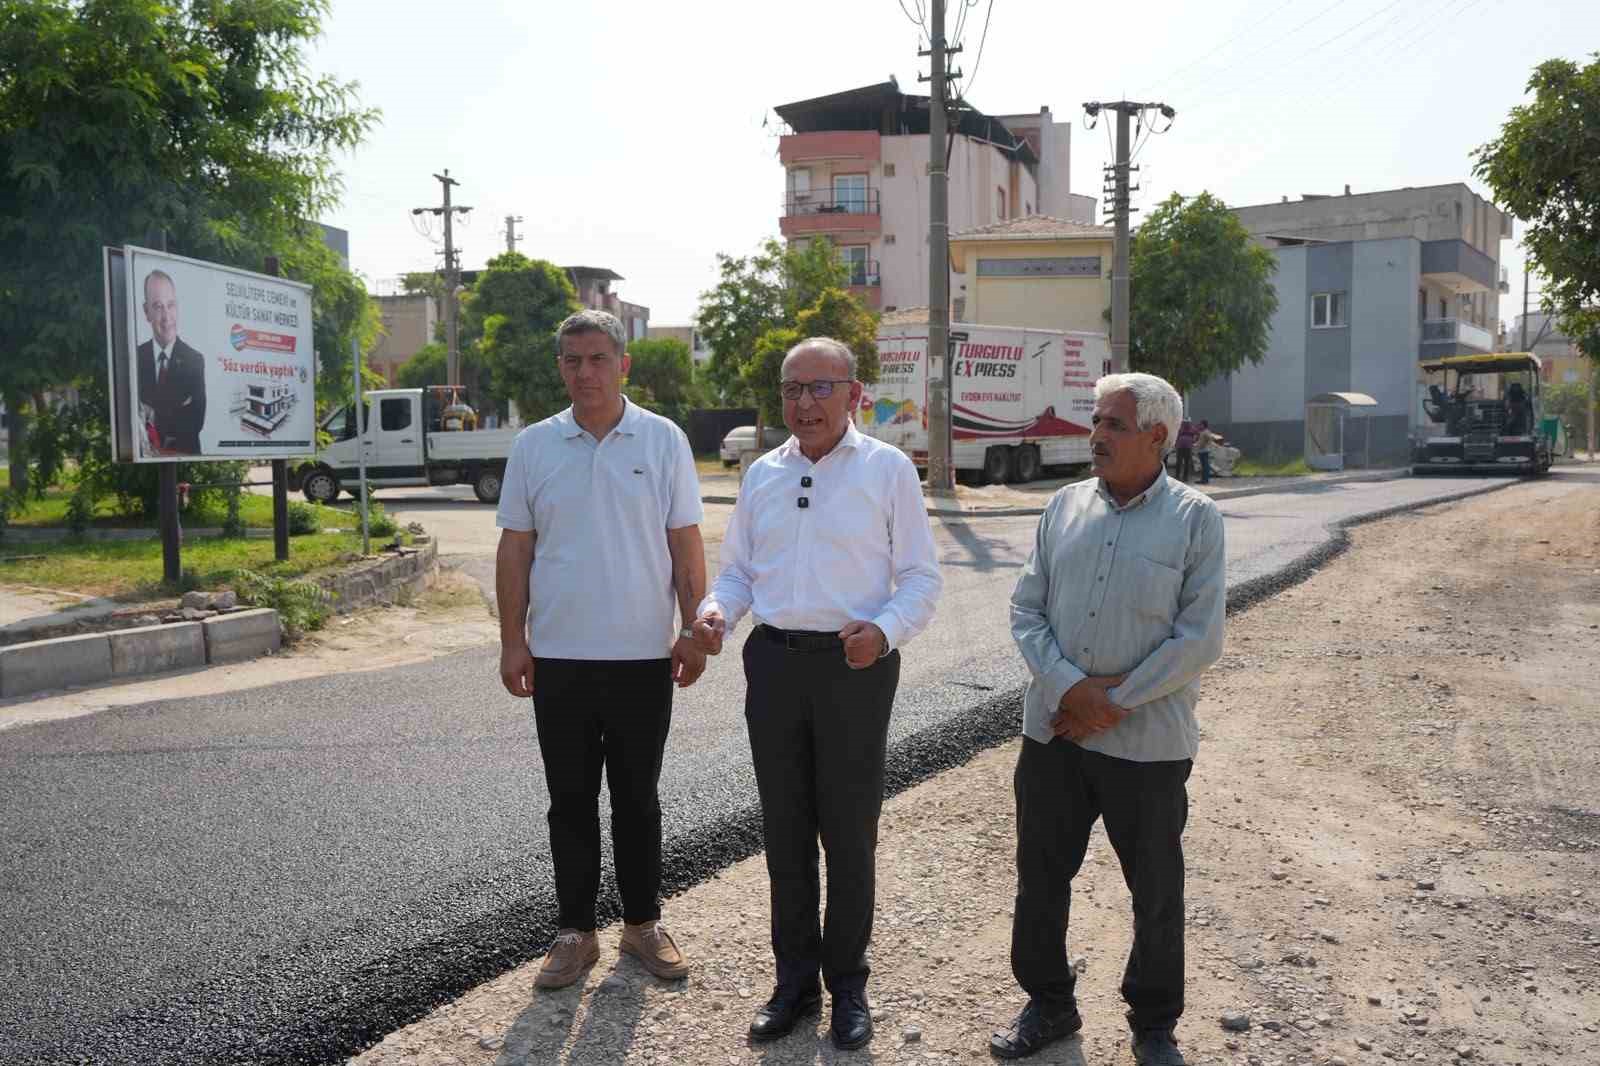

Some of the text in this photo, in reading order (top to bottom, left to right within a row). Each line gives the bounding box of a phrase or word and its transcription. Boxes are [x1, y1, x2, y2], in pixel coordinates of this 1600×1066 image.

[880, 352, 920, 362] URGUTLU
[959, 343, 1025, 361] TURGUTLU
[882, 363, 914, 374] PRESS
[955, 360, 1017, 378] EXPRESS
